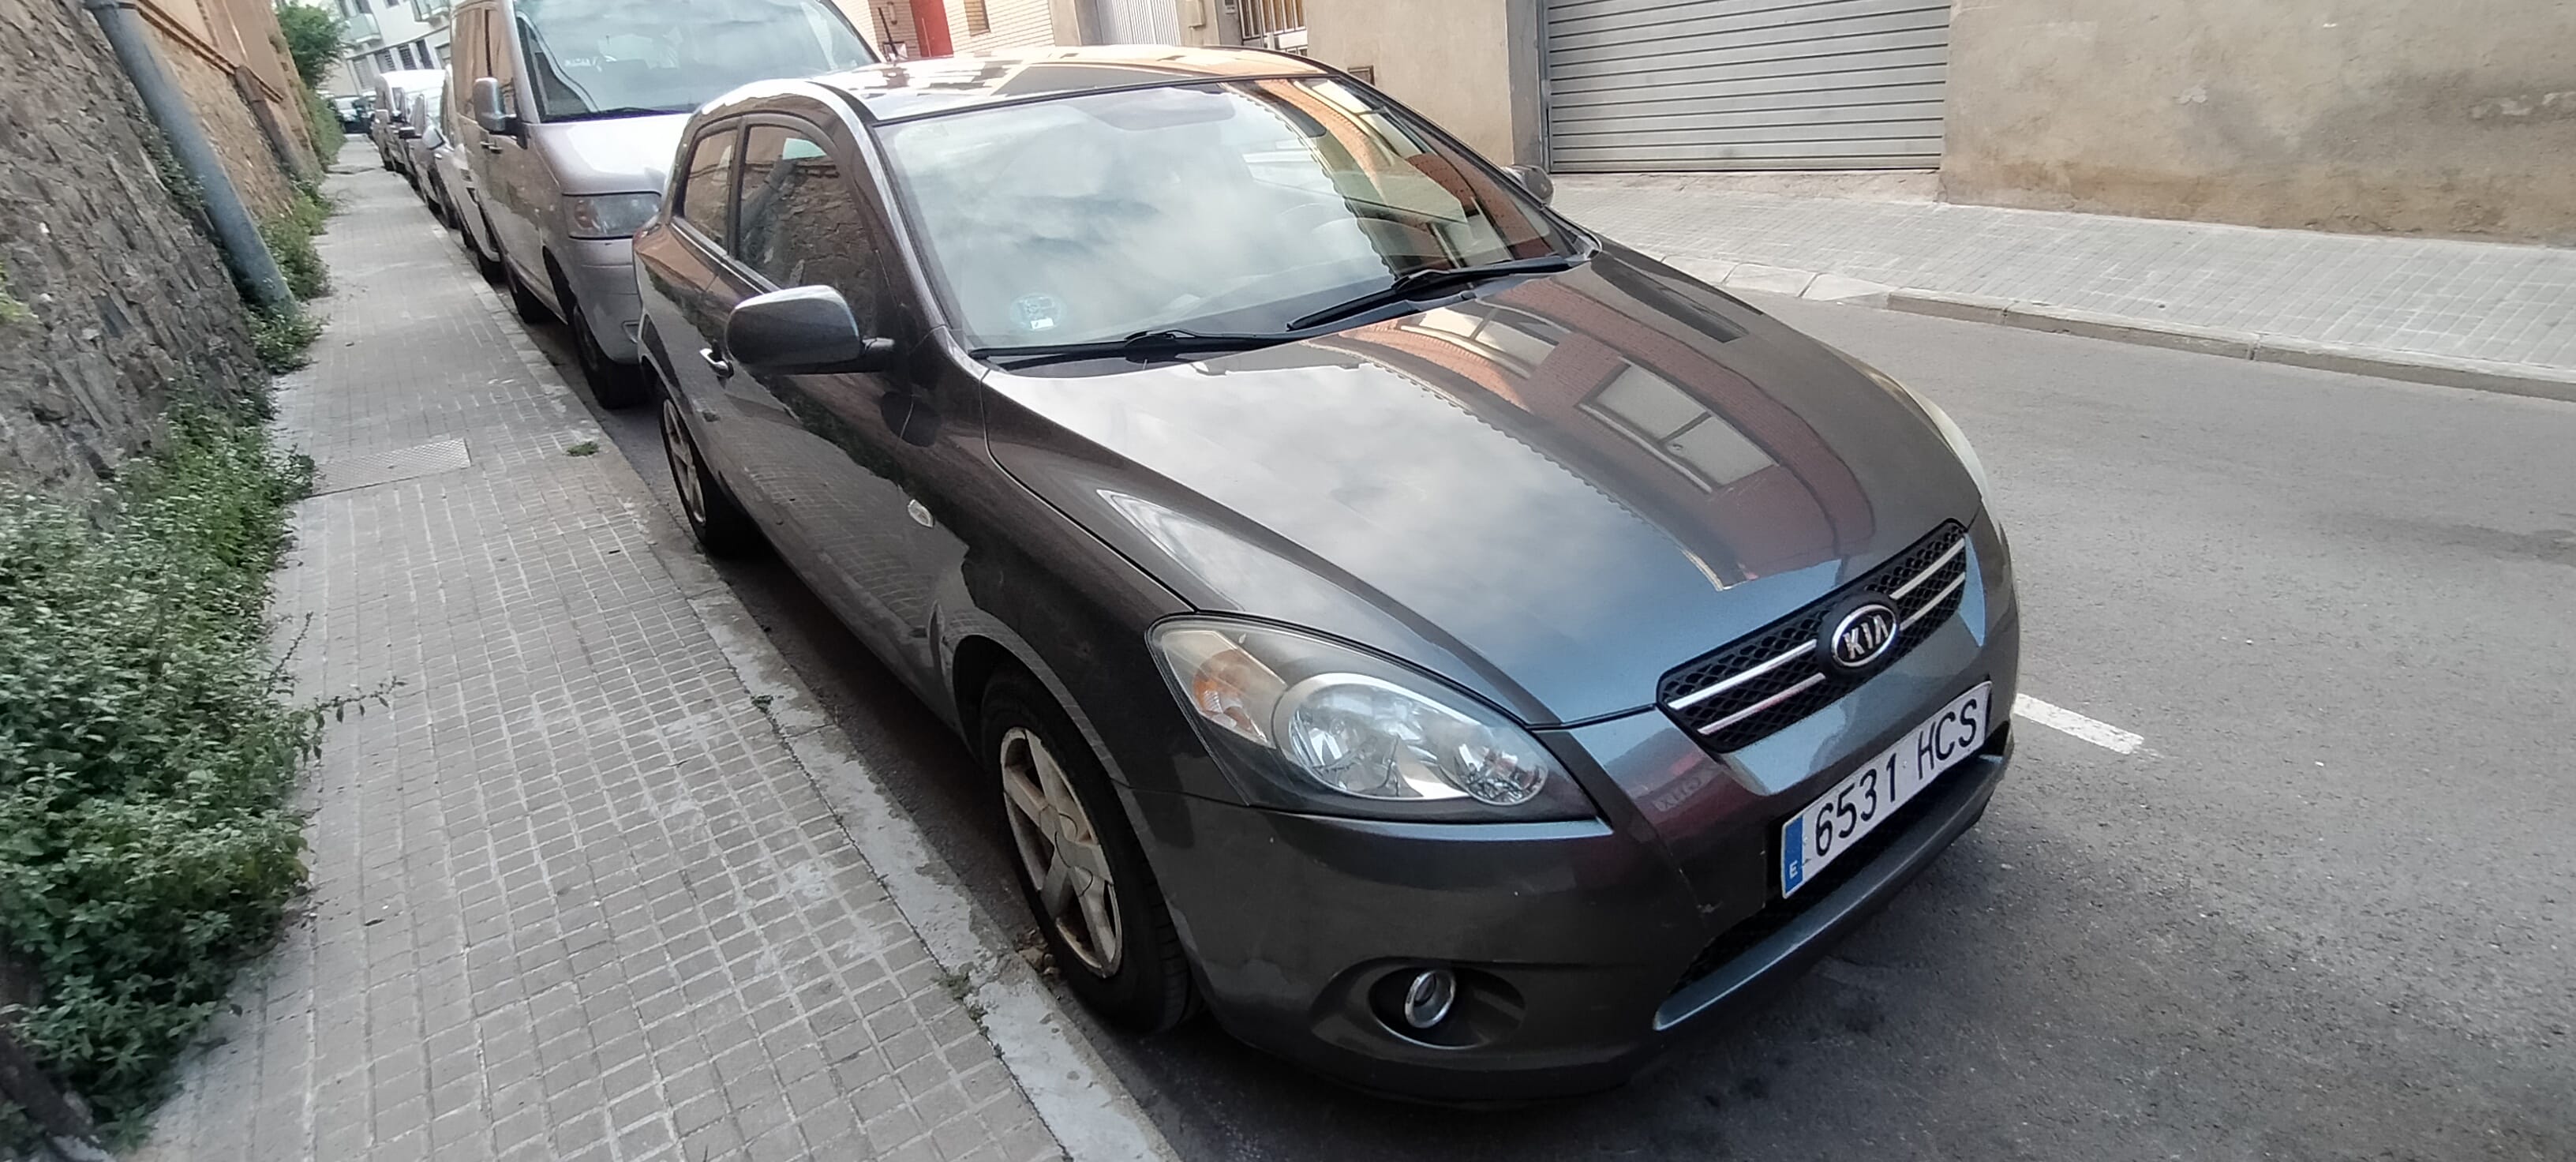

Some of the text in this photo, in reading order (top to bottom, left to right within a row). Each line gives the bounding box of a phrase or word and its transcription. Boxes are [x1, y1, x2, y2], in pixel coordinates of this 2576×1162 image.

[1843, 615, 1889, 659] KIA
[1815, 698, 1978, 857] 6531 HCS
[1788, 860, 1799, 879] E
